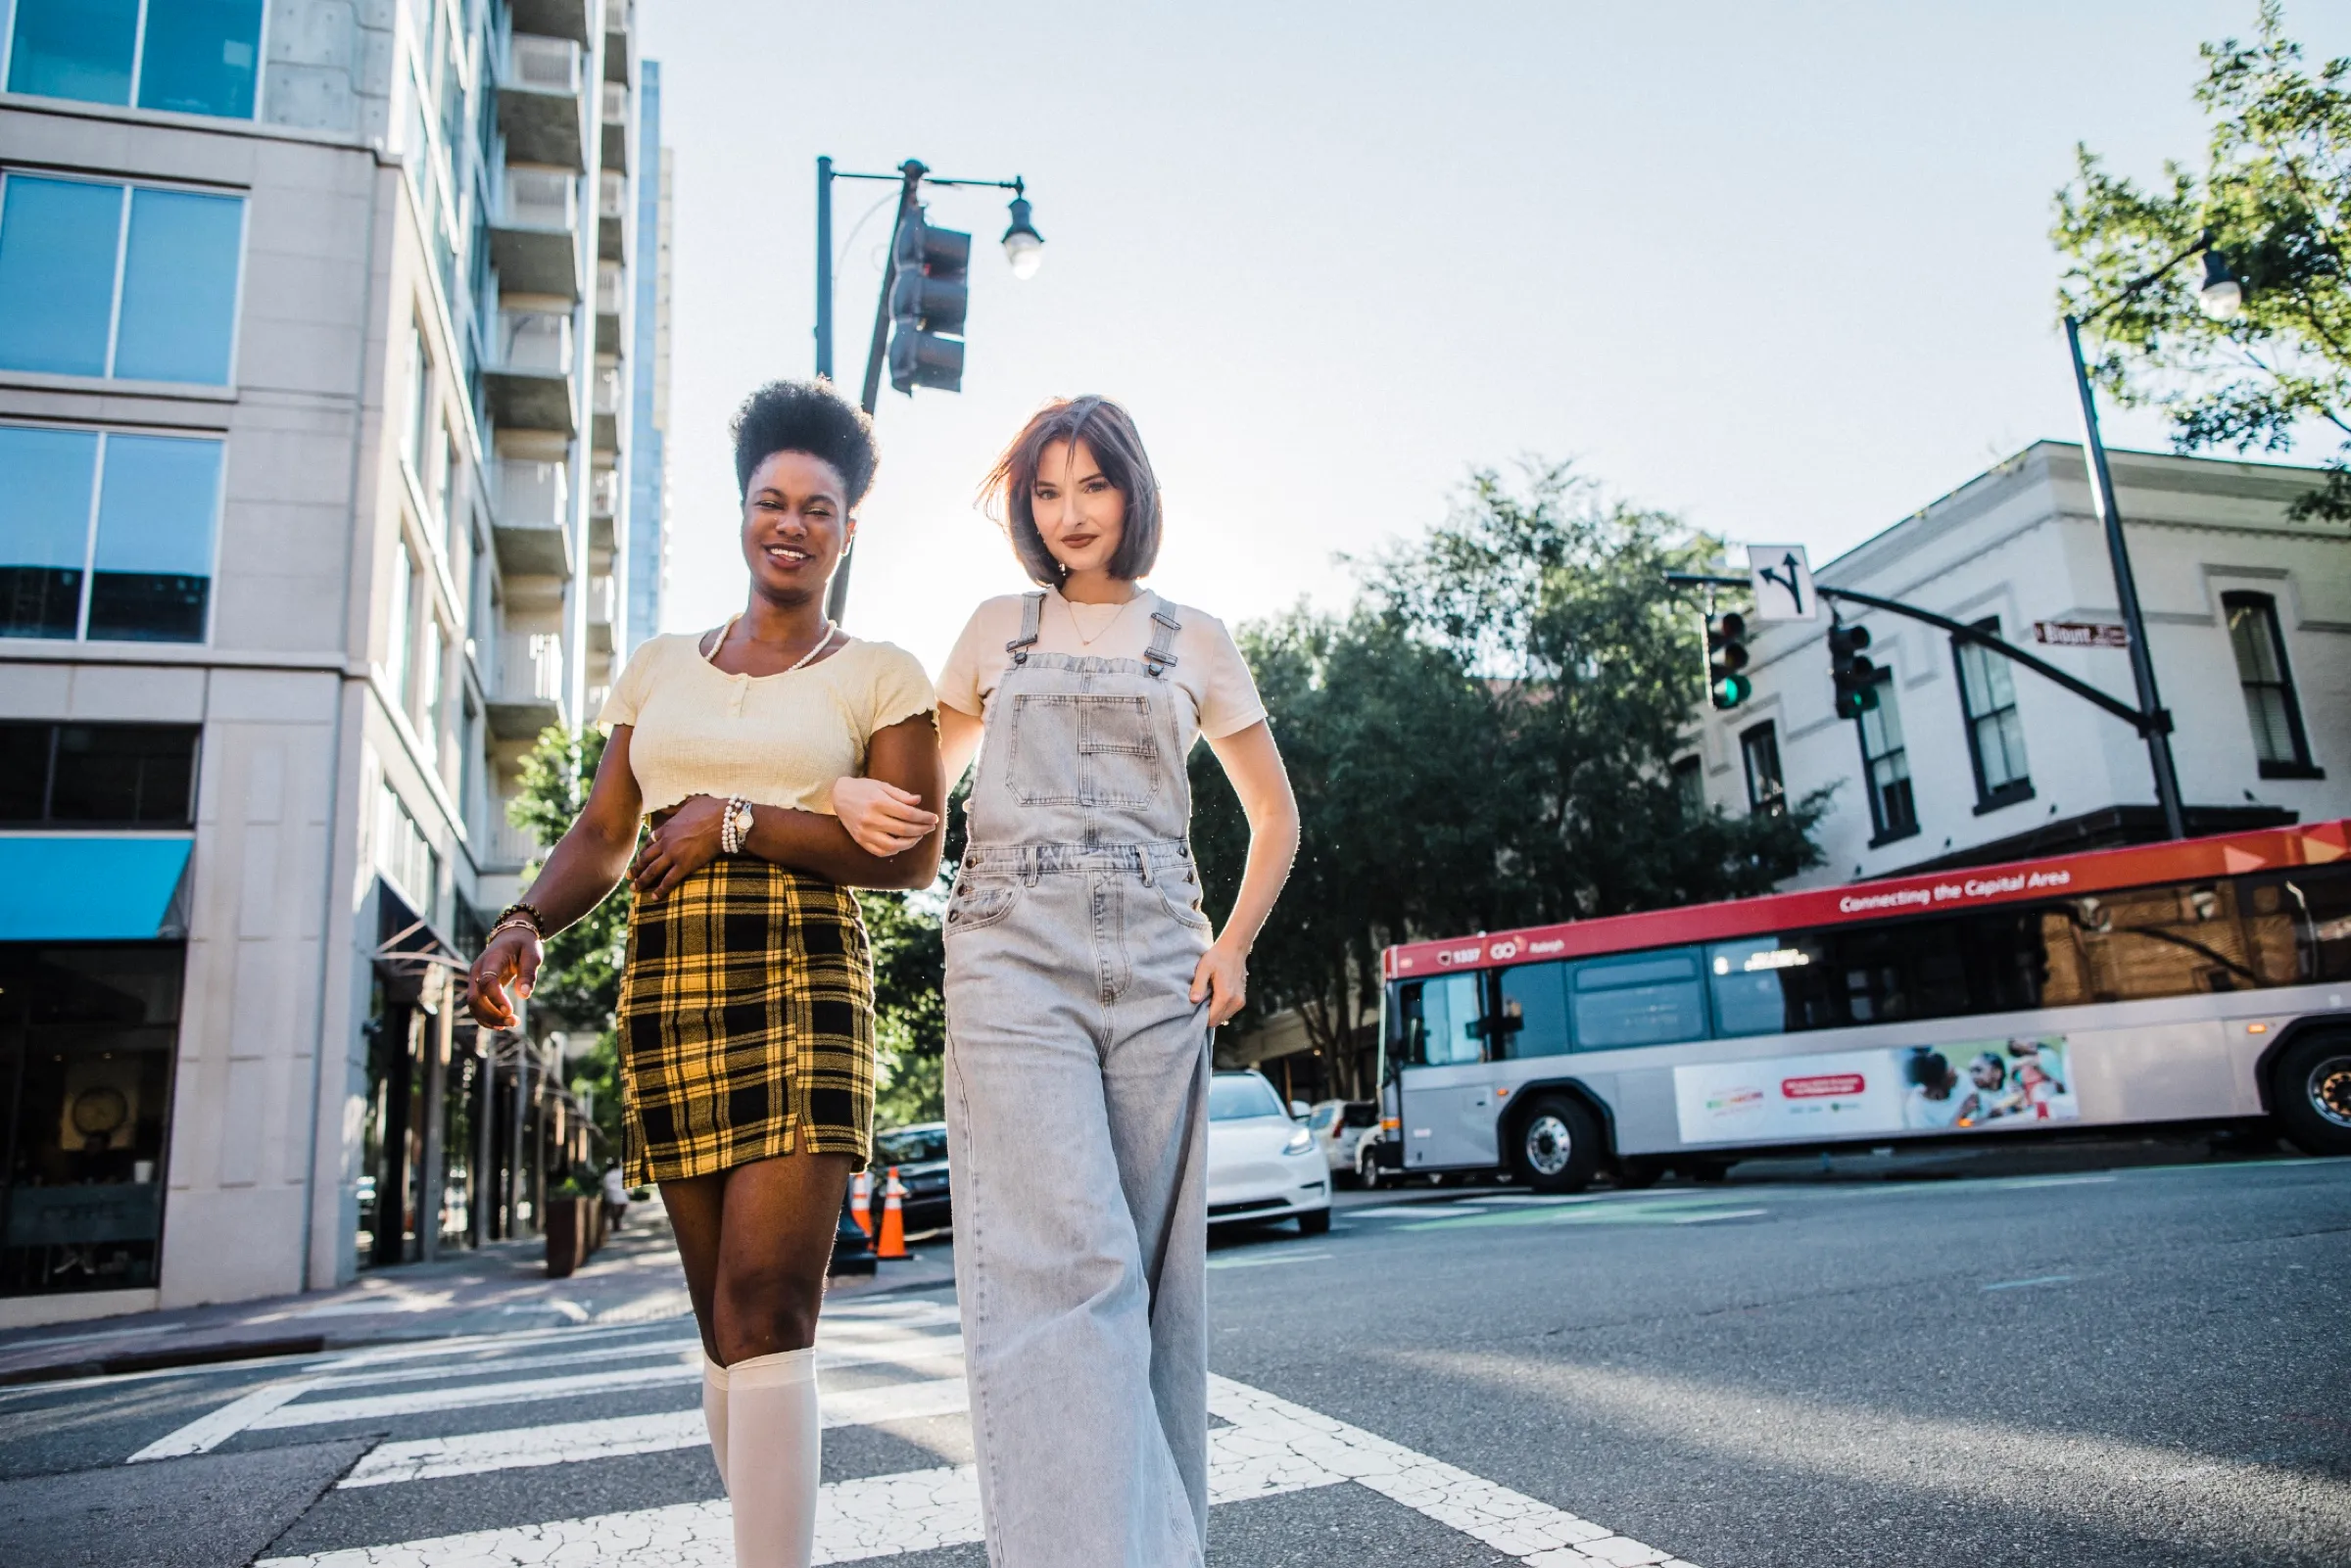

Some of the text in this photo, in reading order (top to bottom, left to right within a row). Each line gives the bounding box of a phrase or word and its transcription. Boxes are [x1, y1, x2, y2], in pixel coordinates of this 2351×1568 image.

[1840, 871, 2070, 913] Connecting the Capital Area
